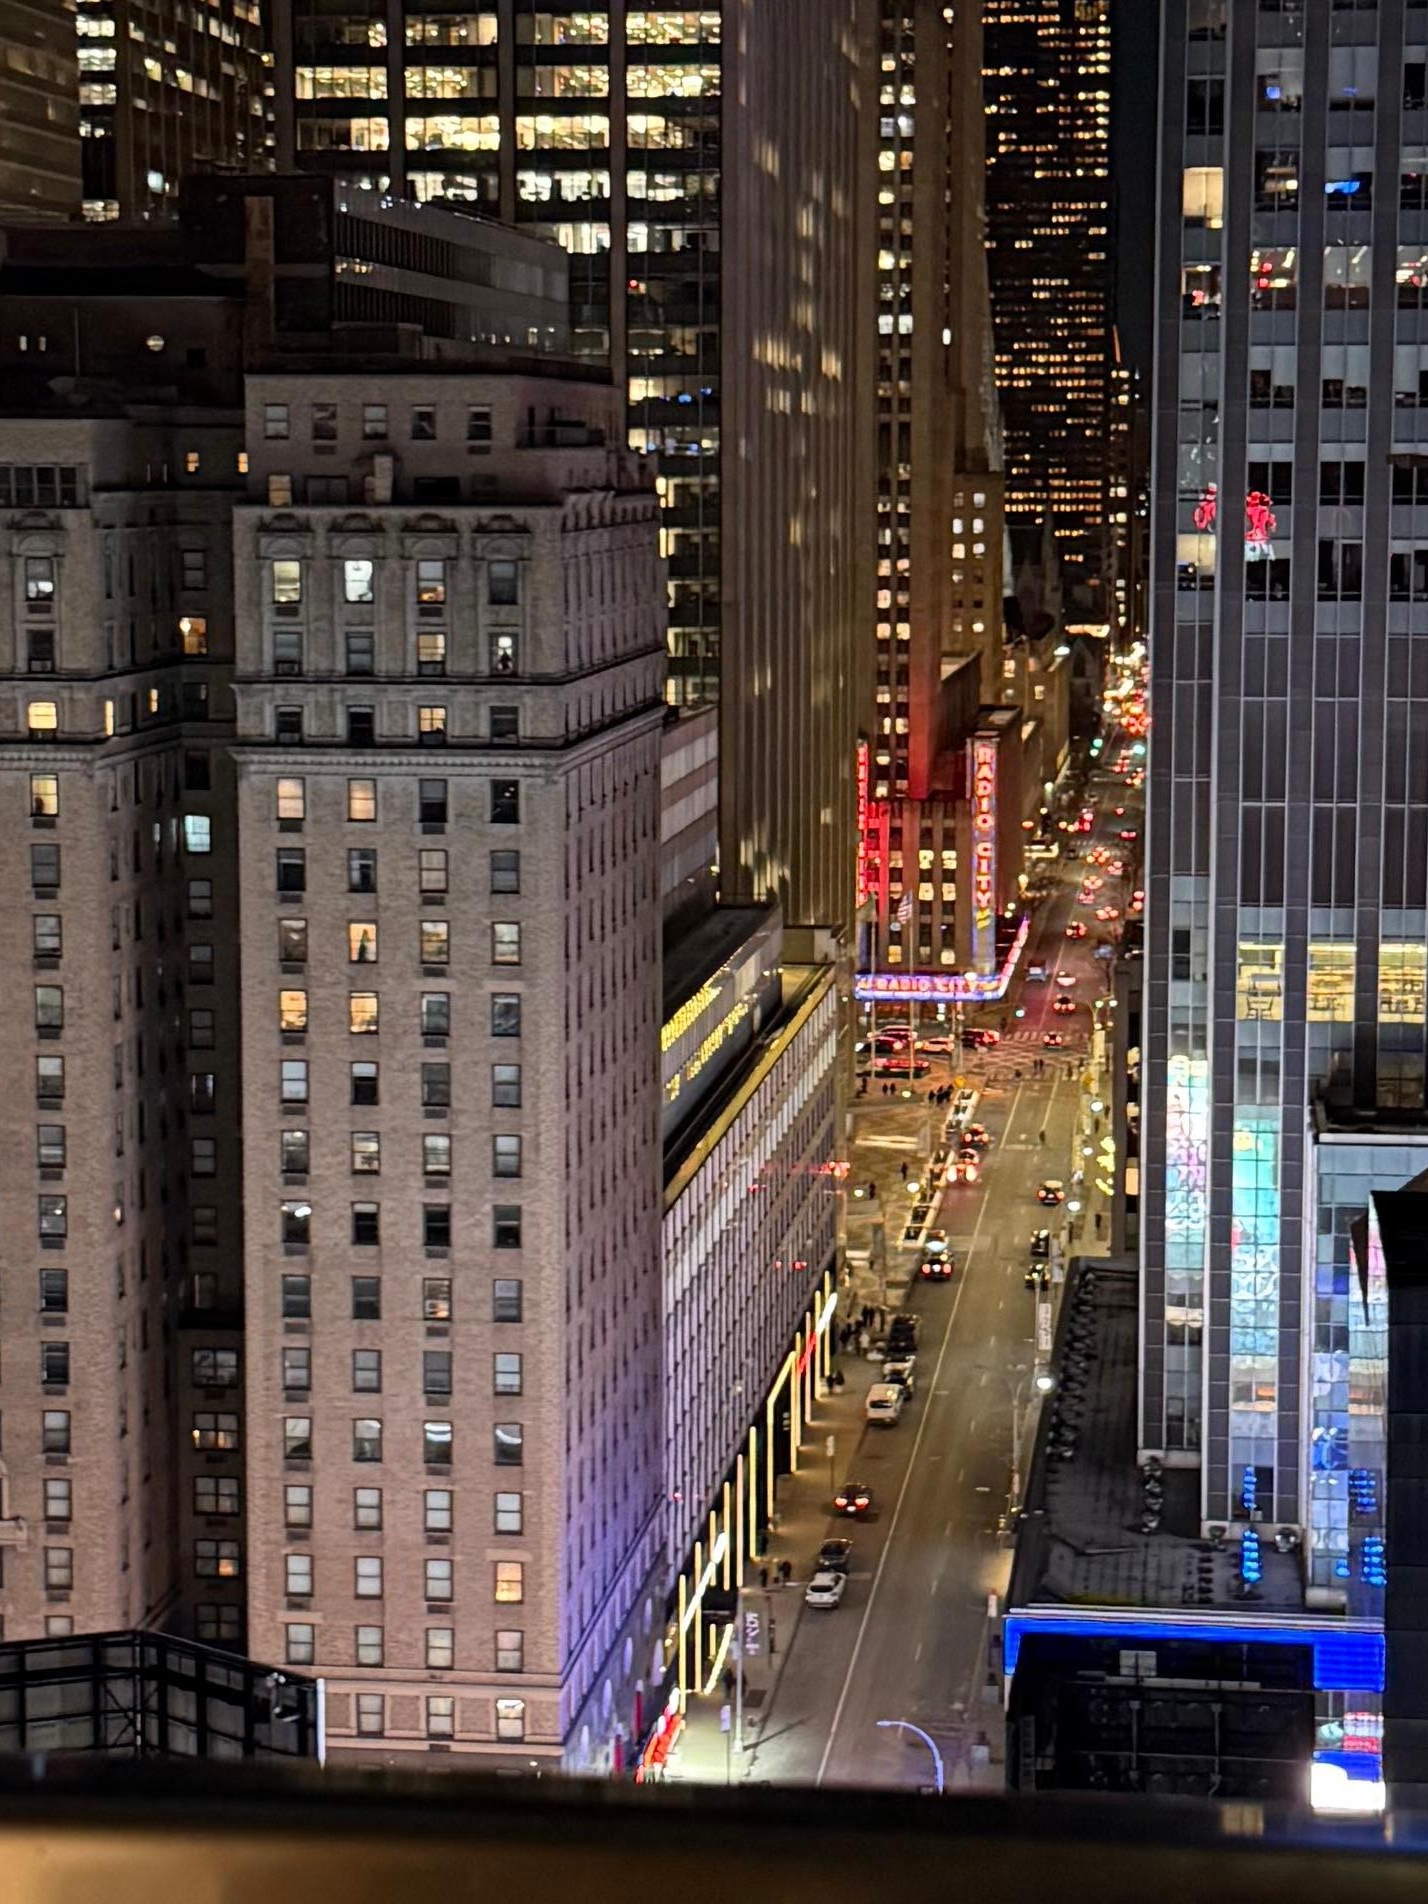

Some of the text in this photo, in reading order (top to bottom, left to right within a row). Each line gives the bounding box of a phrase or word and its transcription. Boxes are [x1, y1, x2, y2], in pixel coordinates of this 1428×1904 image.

[975, 746, 995, 908] RADIO CITY
[876, 977, 930, 992] RADIO
